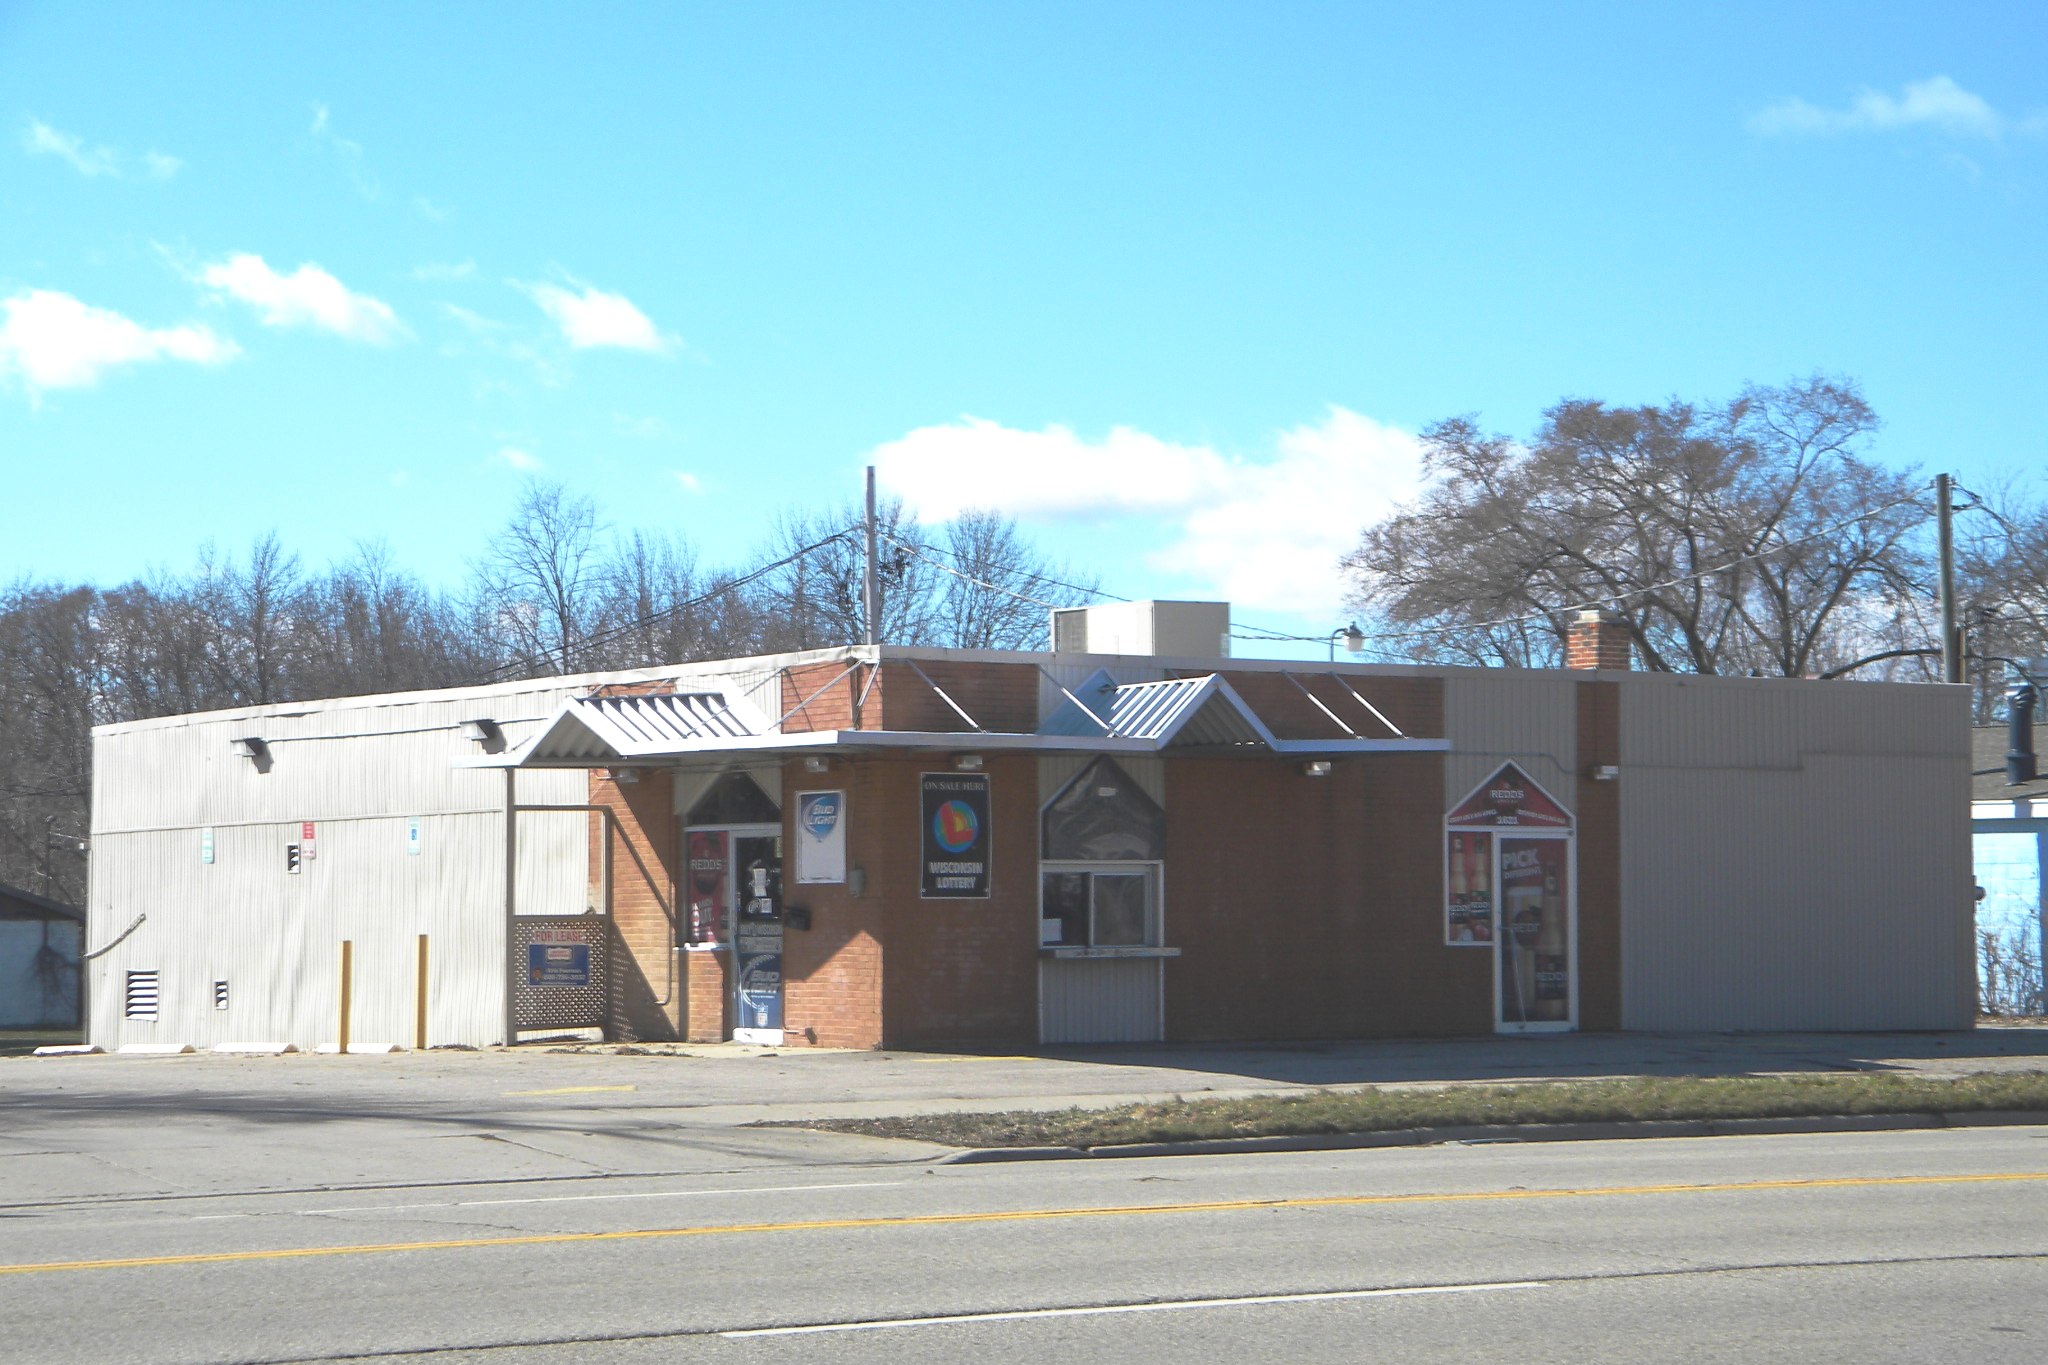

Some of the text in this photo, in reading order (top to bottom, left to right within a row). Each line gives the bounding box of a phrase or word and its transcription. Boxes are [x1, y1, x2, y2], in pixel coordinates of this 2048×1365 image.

[940, 782, 960, 791] SALE
[963, 782, 985, 791] HERE
[812, 804, 835, 815] BUD
[808, 814, 838, 825] LIGHT
[1502, 849, 1539, 871] PICK
[929, 861, 983, 874] WISCONSIN
[936, 877, 977, 889] LOTTERY
[535, 930, 584, 942] FOR LEASE
